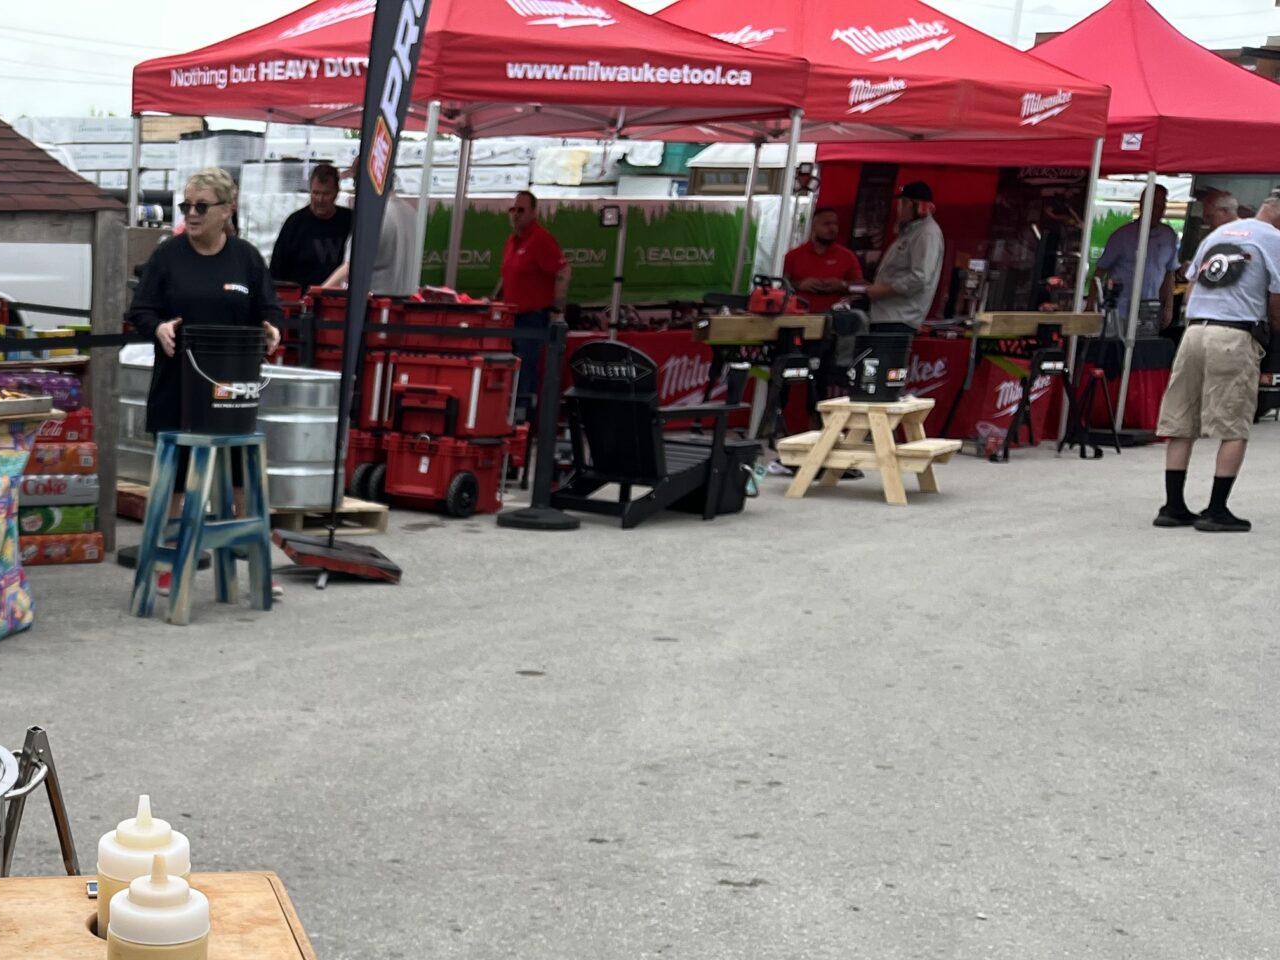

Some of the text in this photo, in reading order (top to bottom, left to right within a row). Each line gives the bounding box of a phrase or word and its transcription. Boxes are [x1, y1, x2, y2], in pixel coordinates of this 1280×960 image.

[831, 18, 949, 56] Milwaukee
[170, 68, 228, 89] Nothing
[230, 64, 257, 84] but
[258, 58, 320, 82] HEAVY
[506, 60, 752, 86] www.milwaukeetool.ca
[847, 77, 908, 105] Milwaukee
[564, 248, 607, 262] COM
[22, 478, 67, 497] Coke
